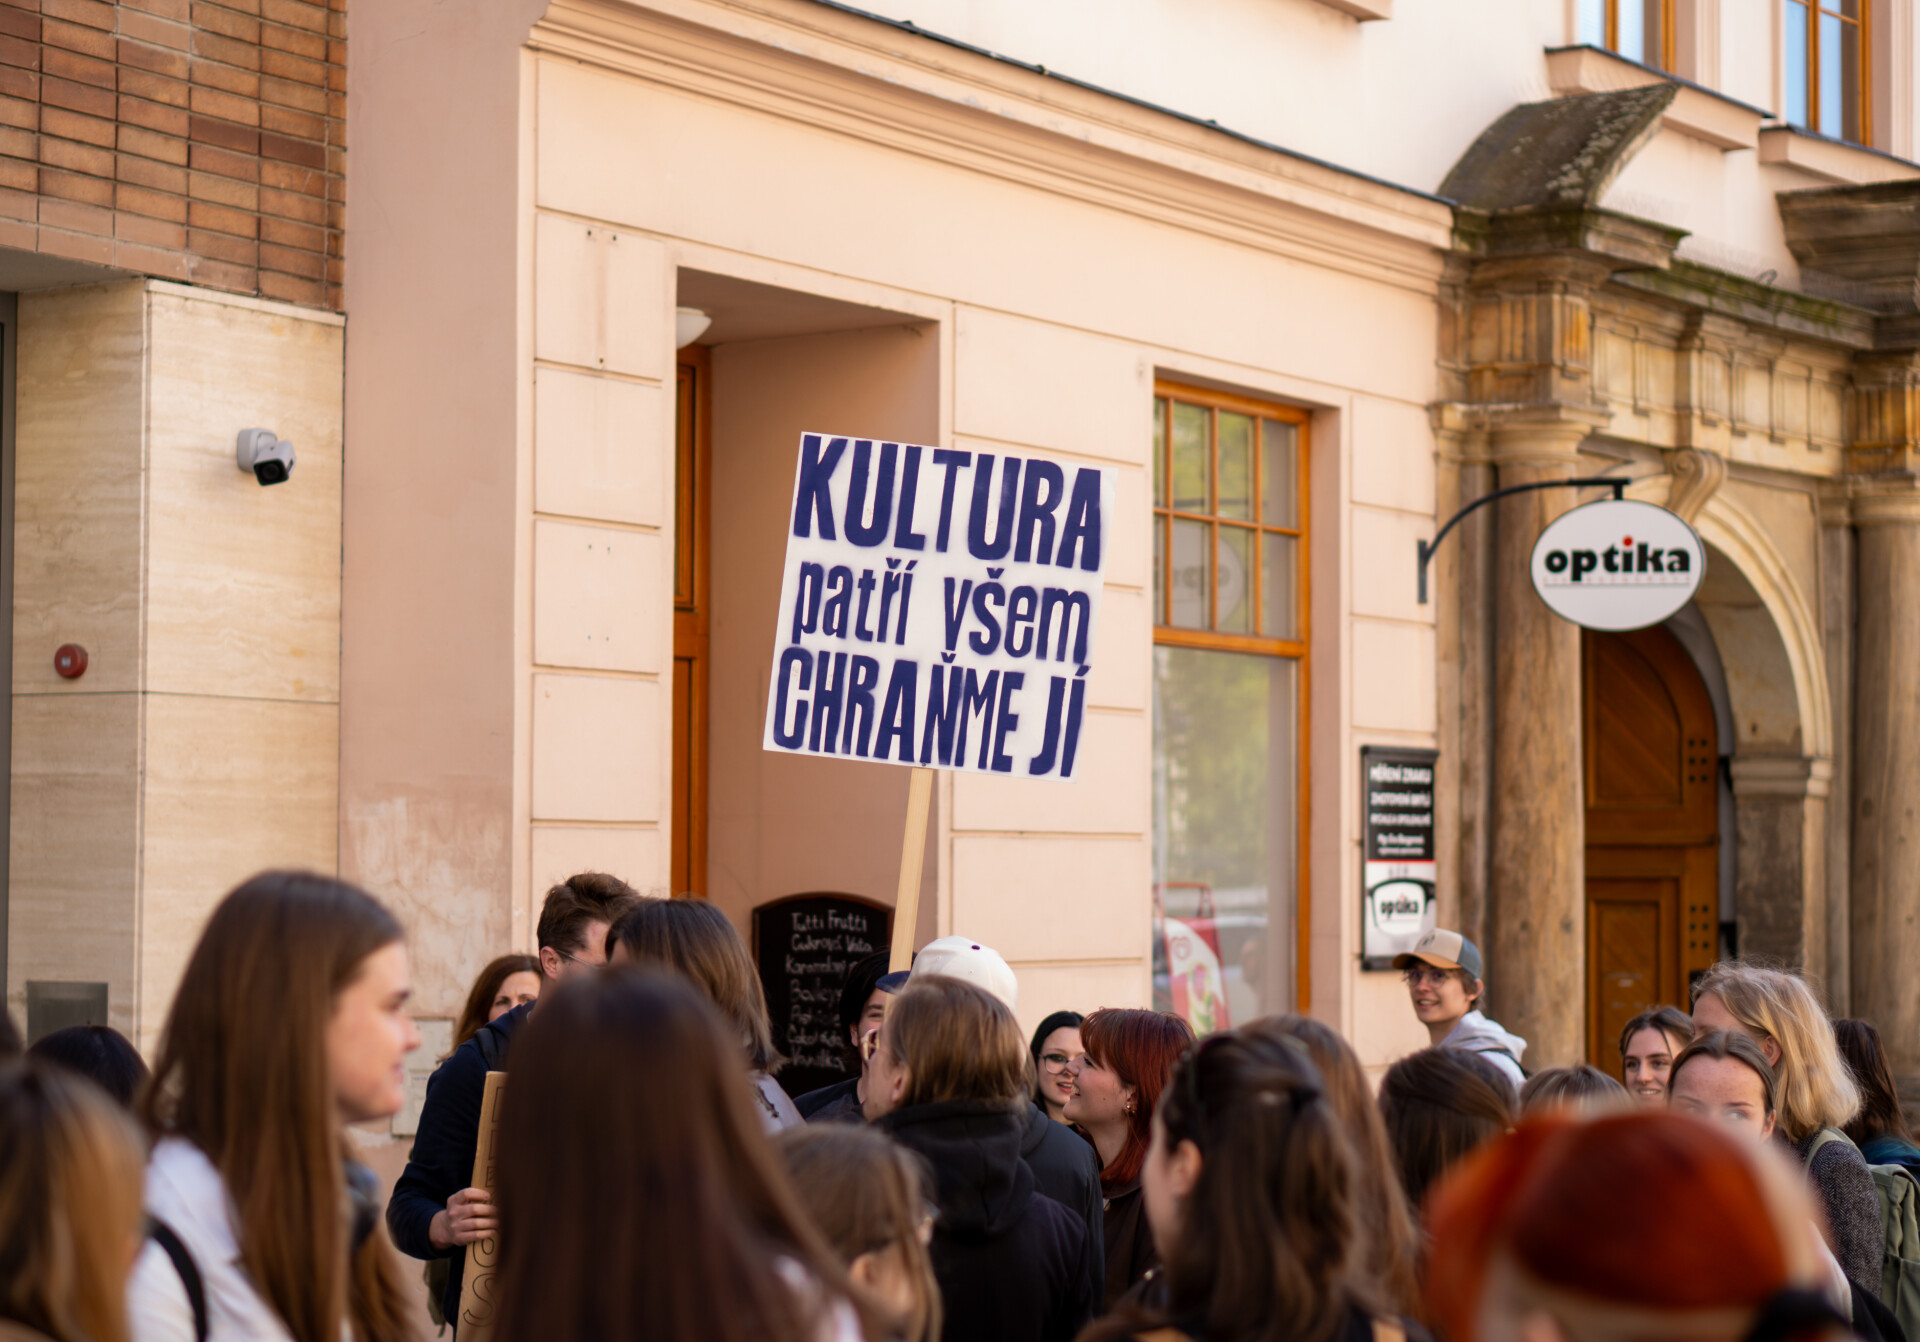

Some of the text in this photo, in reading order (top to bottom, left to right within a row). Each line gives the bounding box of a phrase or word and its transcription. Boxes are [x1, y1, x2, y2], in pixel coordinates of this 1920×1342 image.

[793, 433, 1102, 572] KULTURA
[1545, 535, 1690, 582] optika
[791, 557, 1090, 664] patří všem
[773, 646, 1091, 777] CHRAŇME JÍ
[791, 909, 868, 932] Tutti Frutti
[1380, 893, 1419, 919] optika
